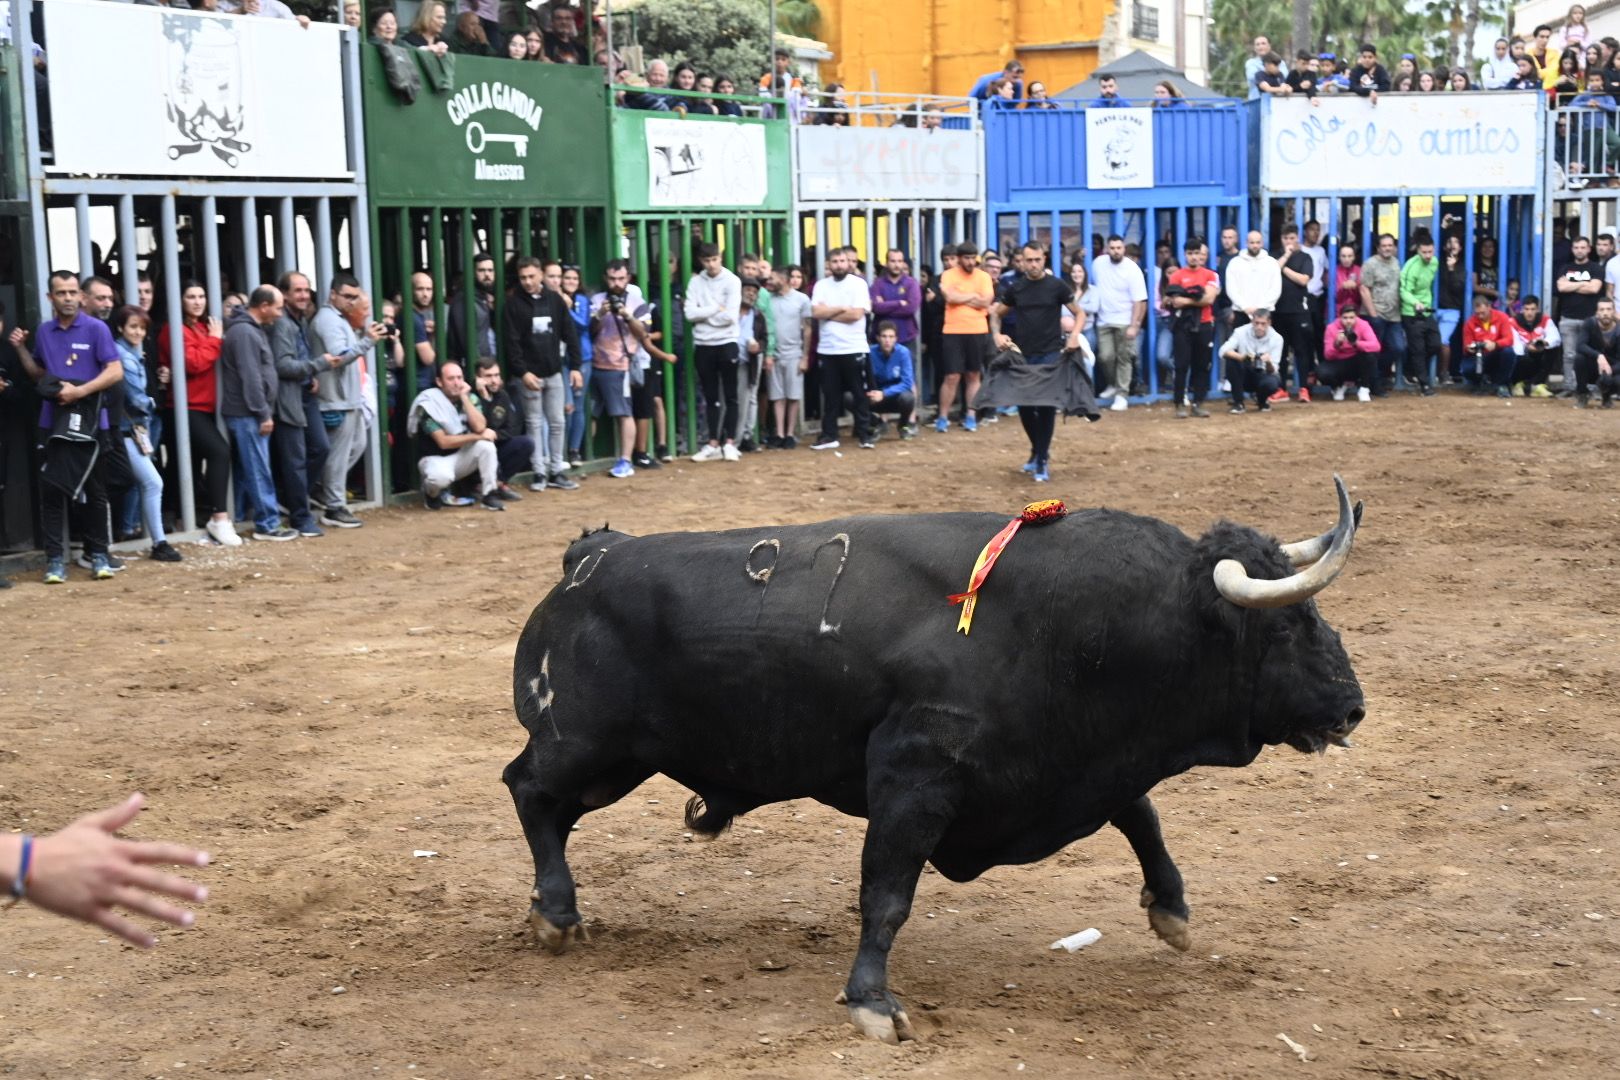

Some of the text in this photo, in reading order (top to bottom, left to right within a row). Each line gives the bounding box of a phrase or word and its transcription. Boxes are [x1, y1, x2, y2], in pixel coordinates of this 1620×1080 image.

[447, 81, 543, 131] COLLA GANDIA
[1276, 114, 1520, 165] Colla els amics
